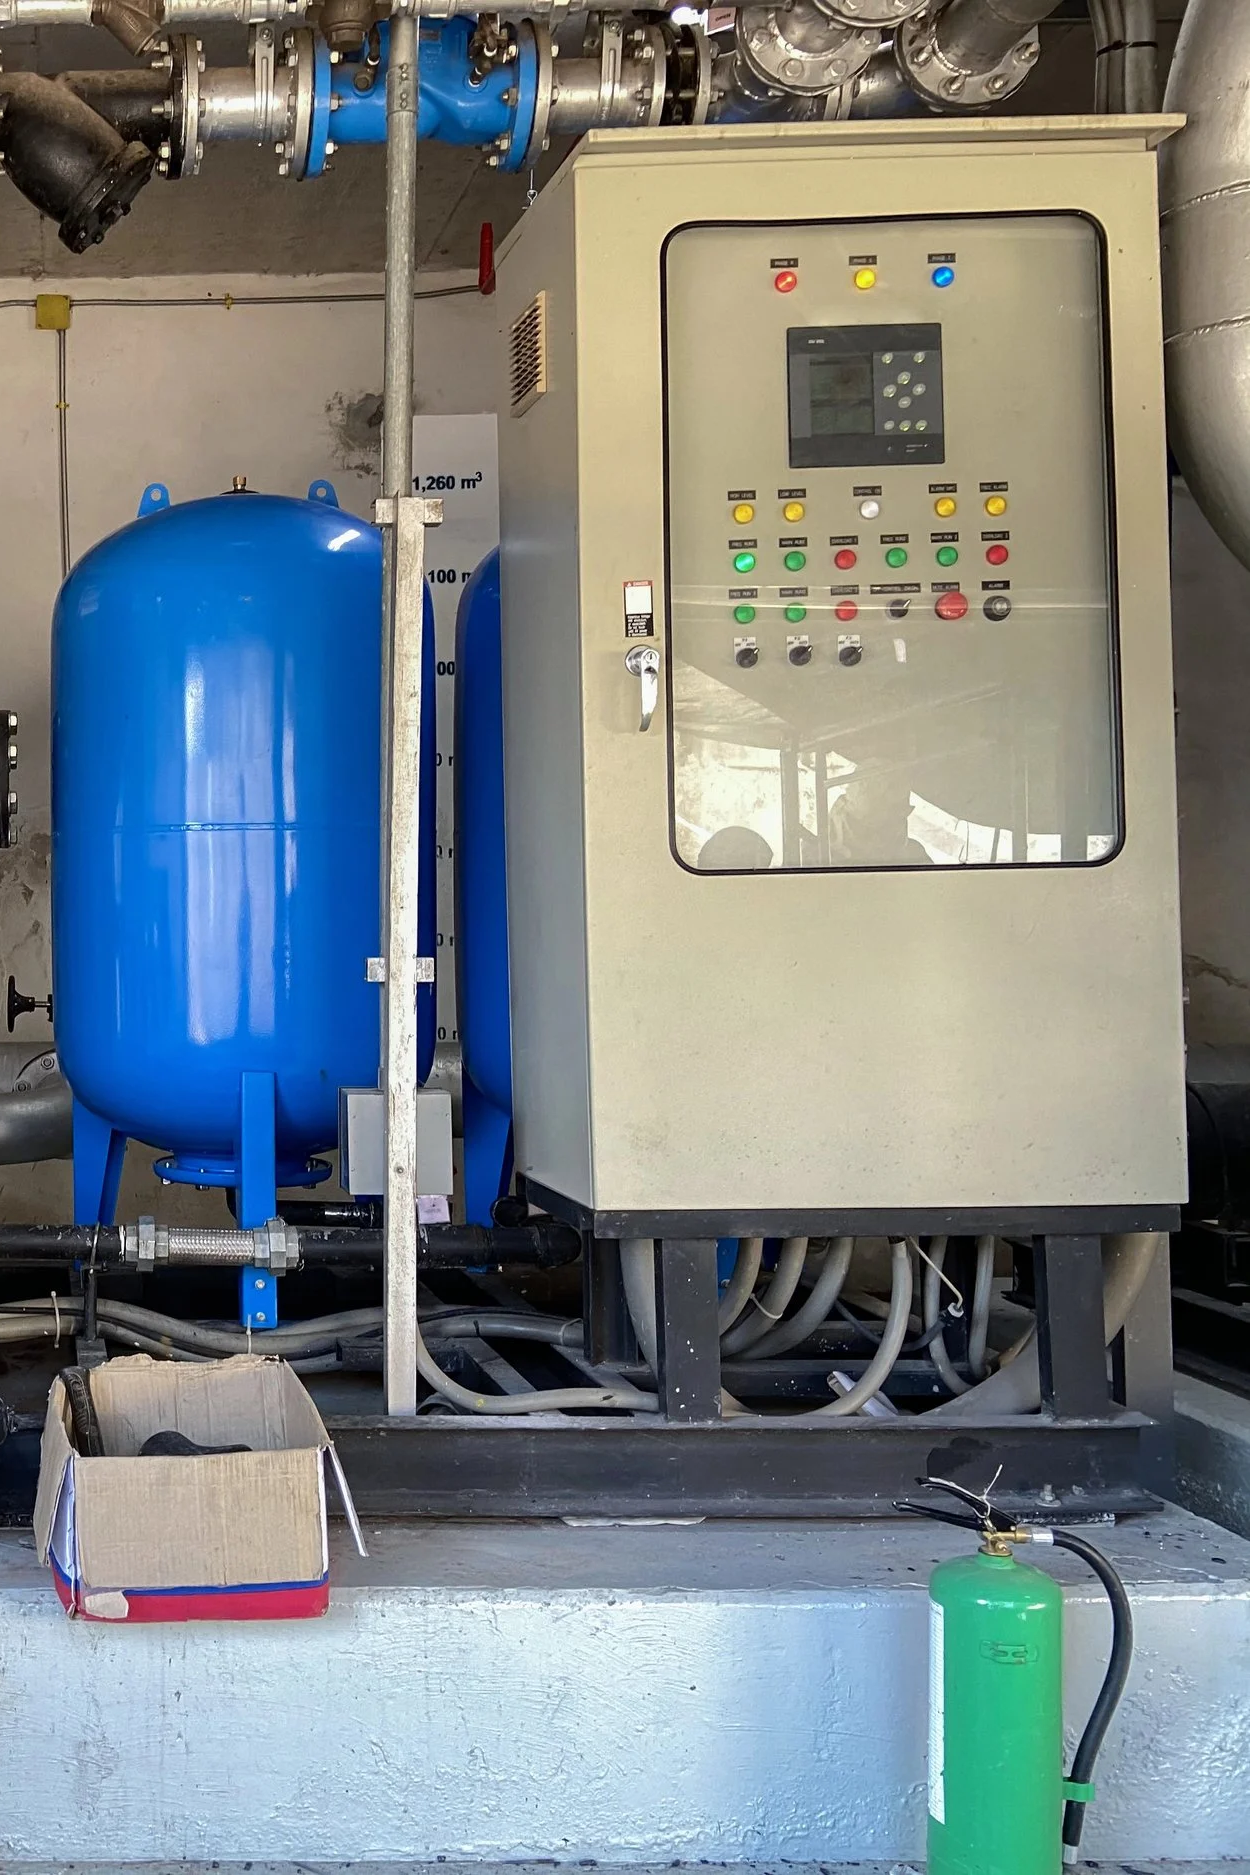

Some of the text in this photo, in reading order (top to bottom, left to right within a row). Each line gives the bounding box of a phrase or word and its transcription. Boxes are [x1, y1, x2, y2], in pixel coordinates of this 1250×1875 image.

[411, 475, 456, 493] 1,260
[428, 569, 456, 583] 100
[437, 661, 455, 676] 00
